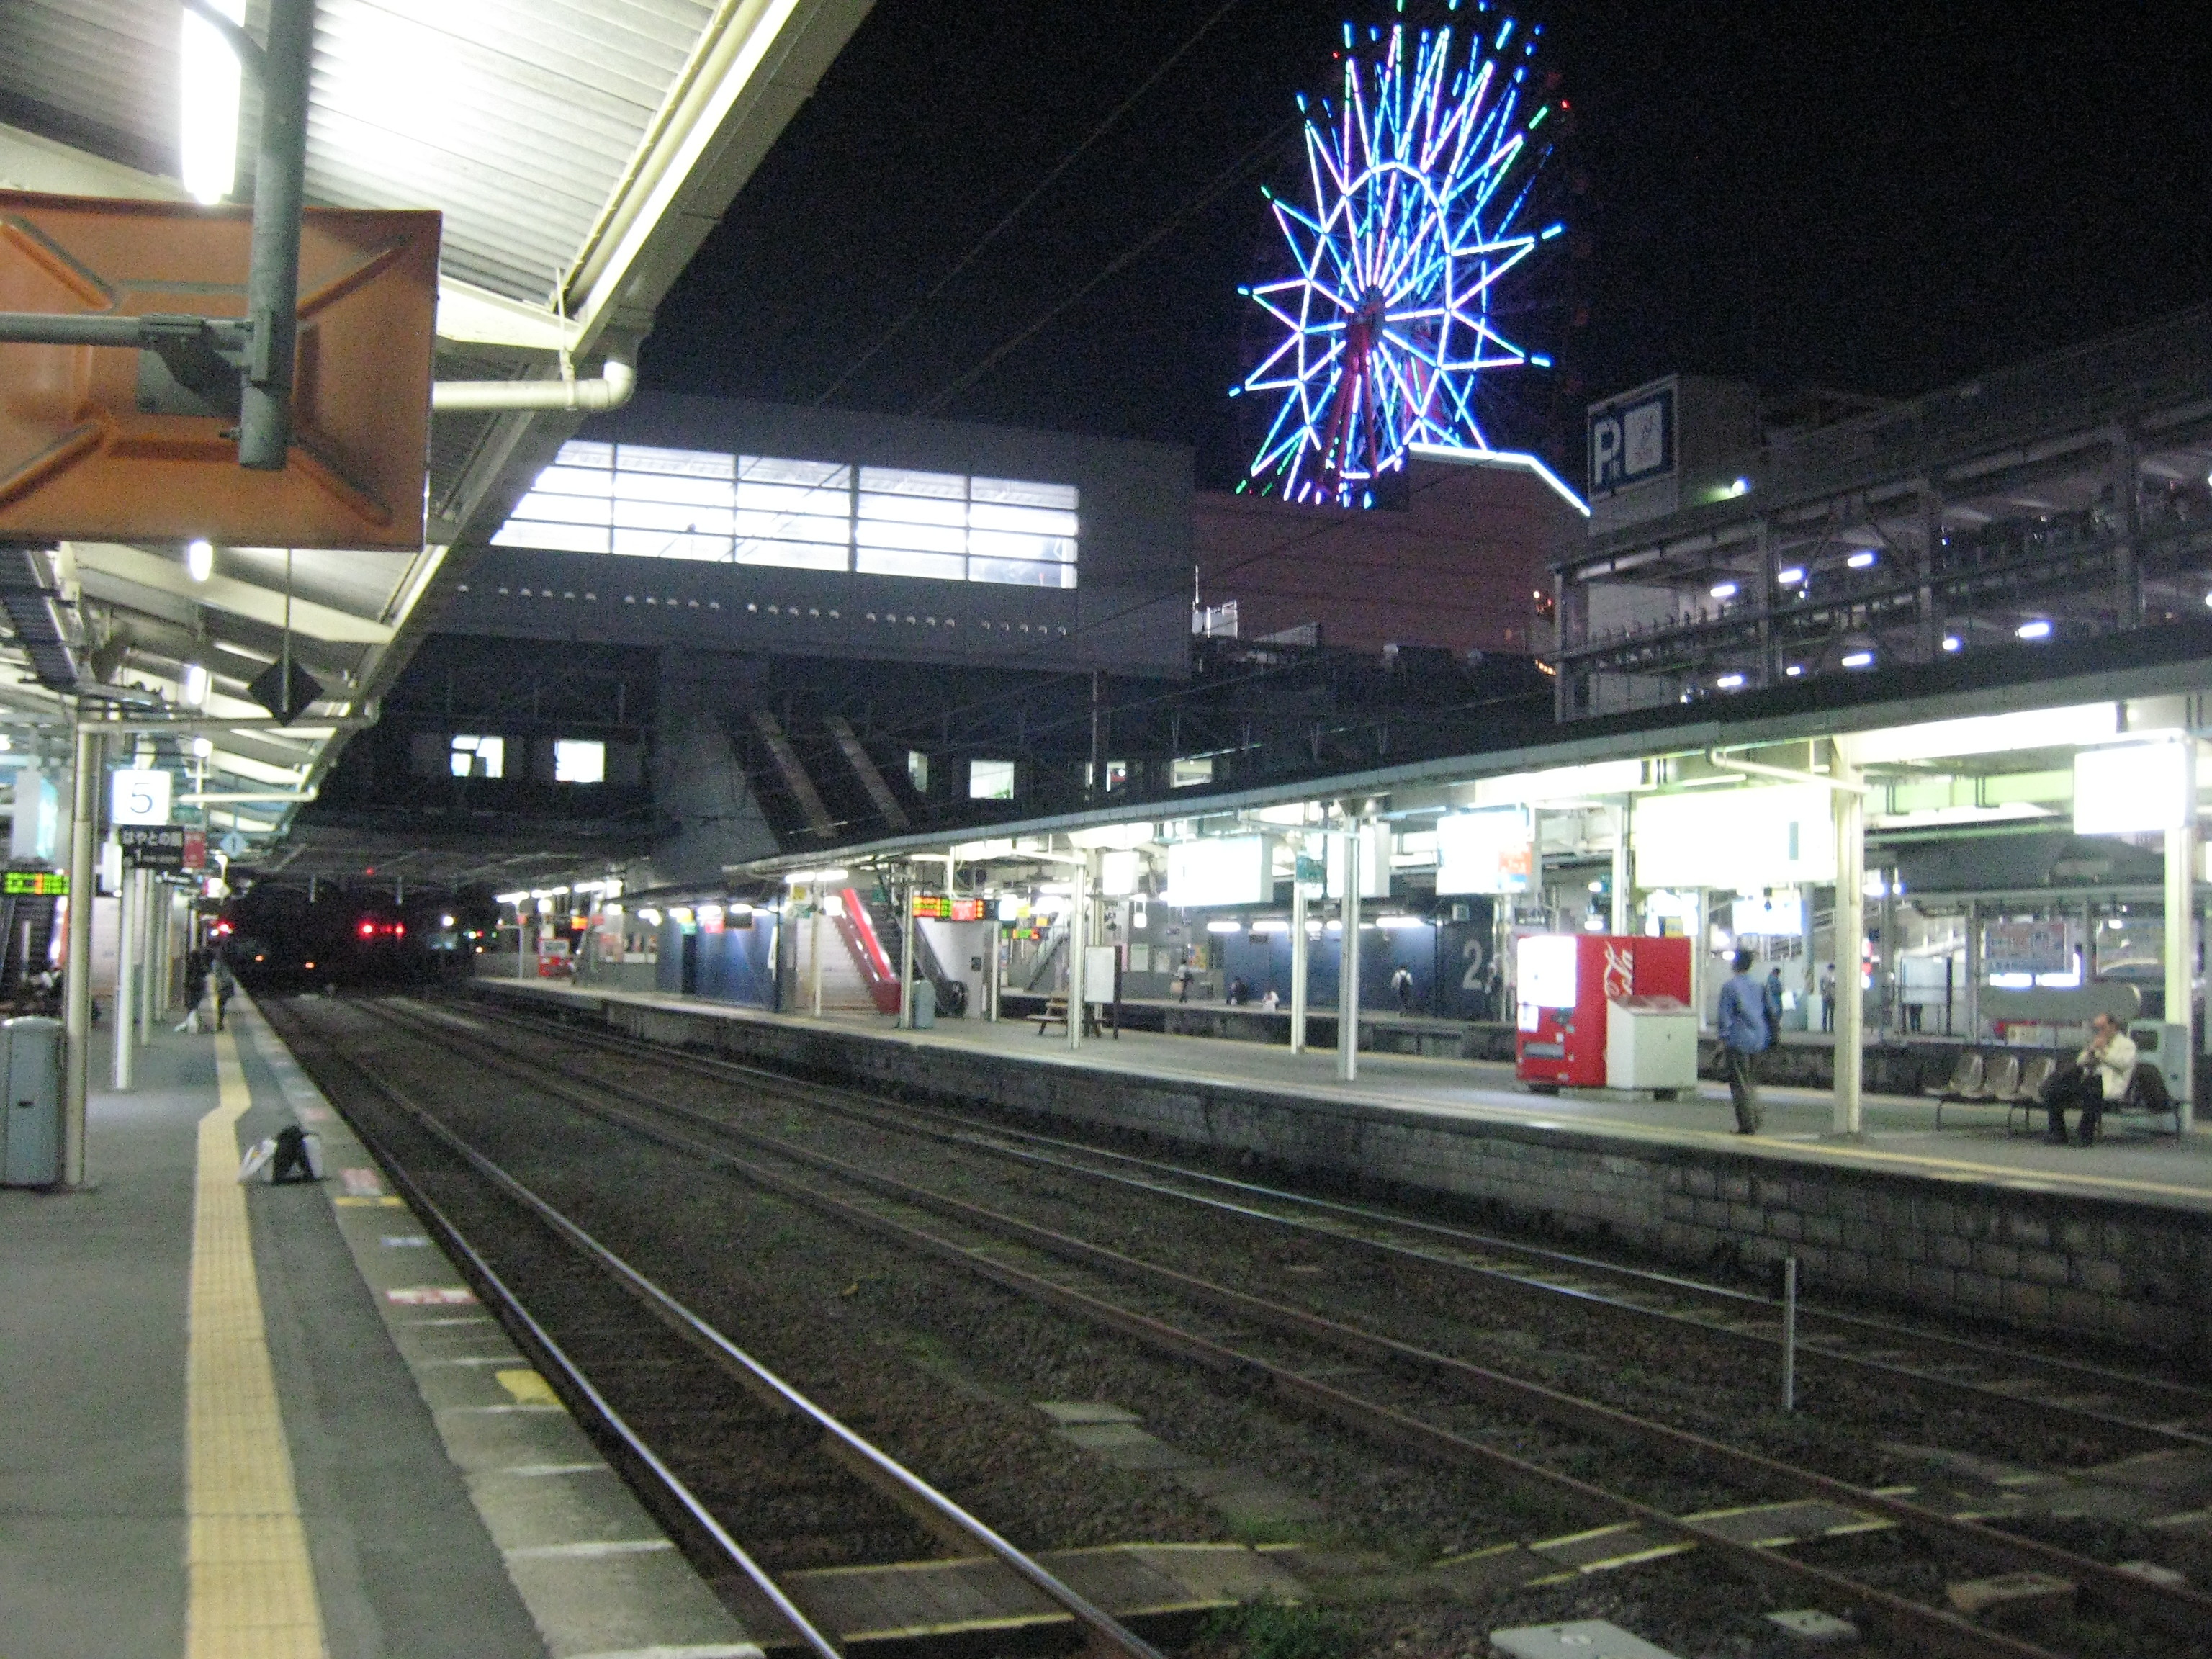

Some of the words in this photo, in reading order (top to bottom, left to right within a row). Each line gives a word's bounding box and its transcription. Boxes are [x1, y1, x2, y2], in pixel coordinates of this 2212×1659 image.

[1594, 418, 1621, 484] P
[130, 782, 153, 814] 5
[1462, 939, 1483, 990] 2
